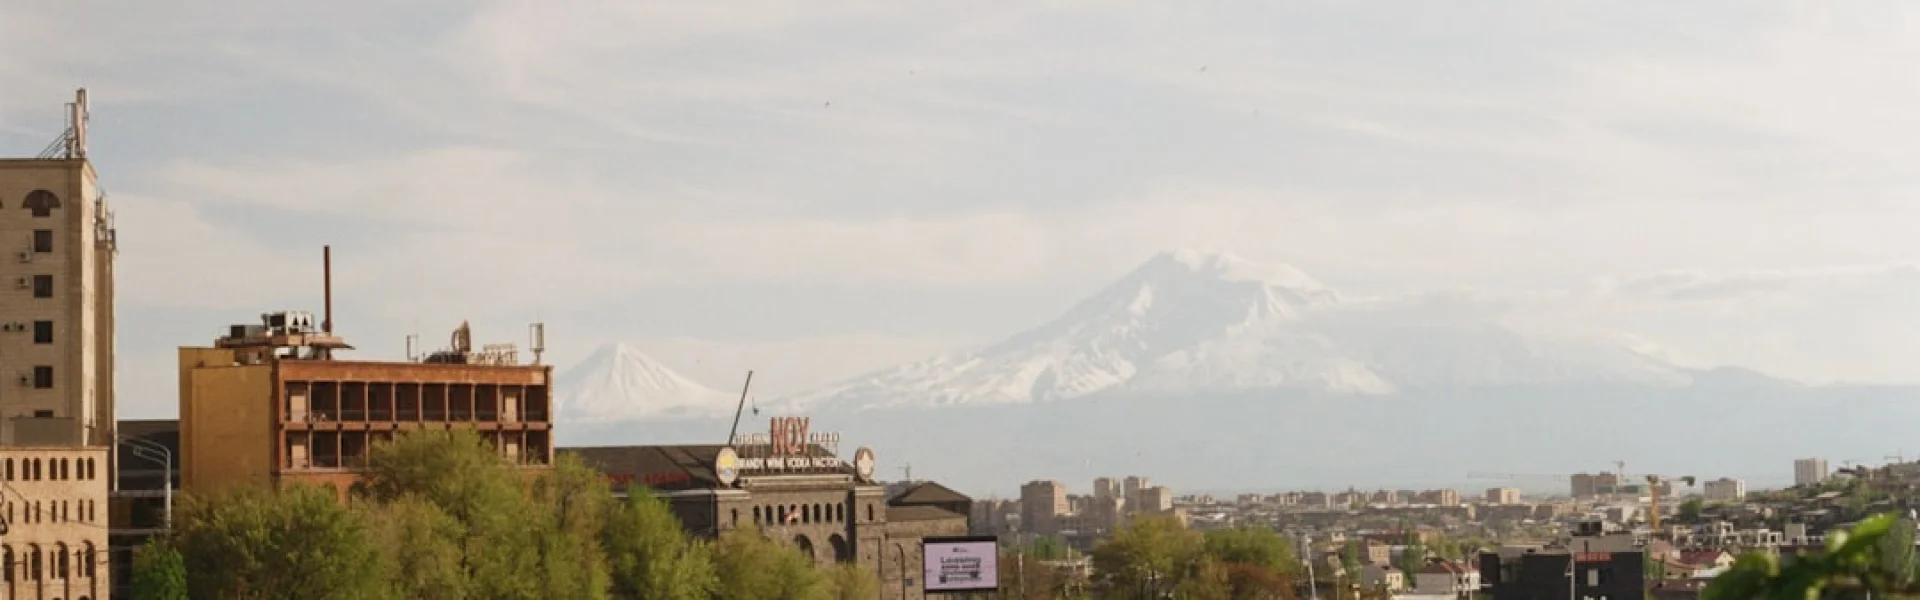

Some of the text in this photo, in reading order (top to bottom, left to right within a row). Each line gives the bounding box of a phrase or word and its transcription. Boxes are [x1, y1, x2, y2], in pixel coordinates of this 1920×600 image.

[771, 417, 809, 454] NOY
[767, 458, 784, 470] WINE
[787, 457, 810, 469] VODKA
[812, 457, 842, 469] FACTORY
